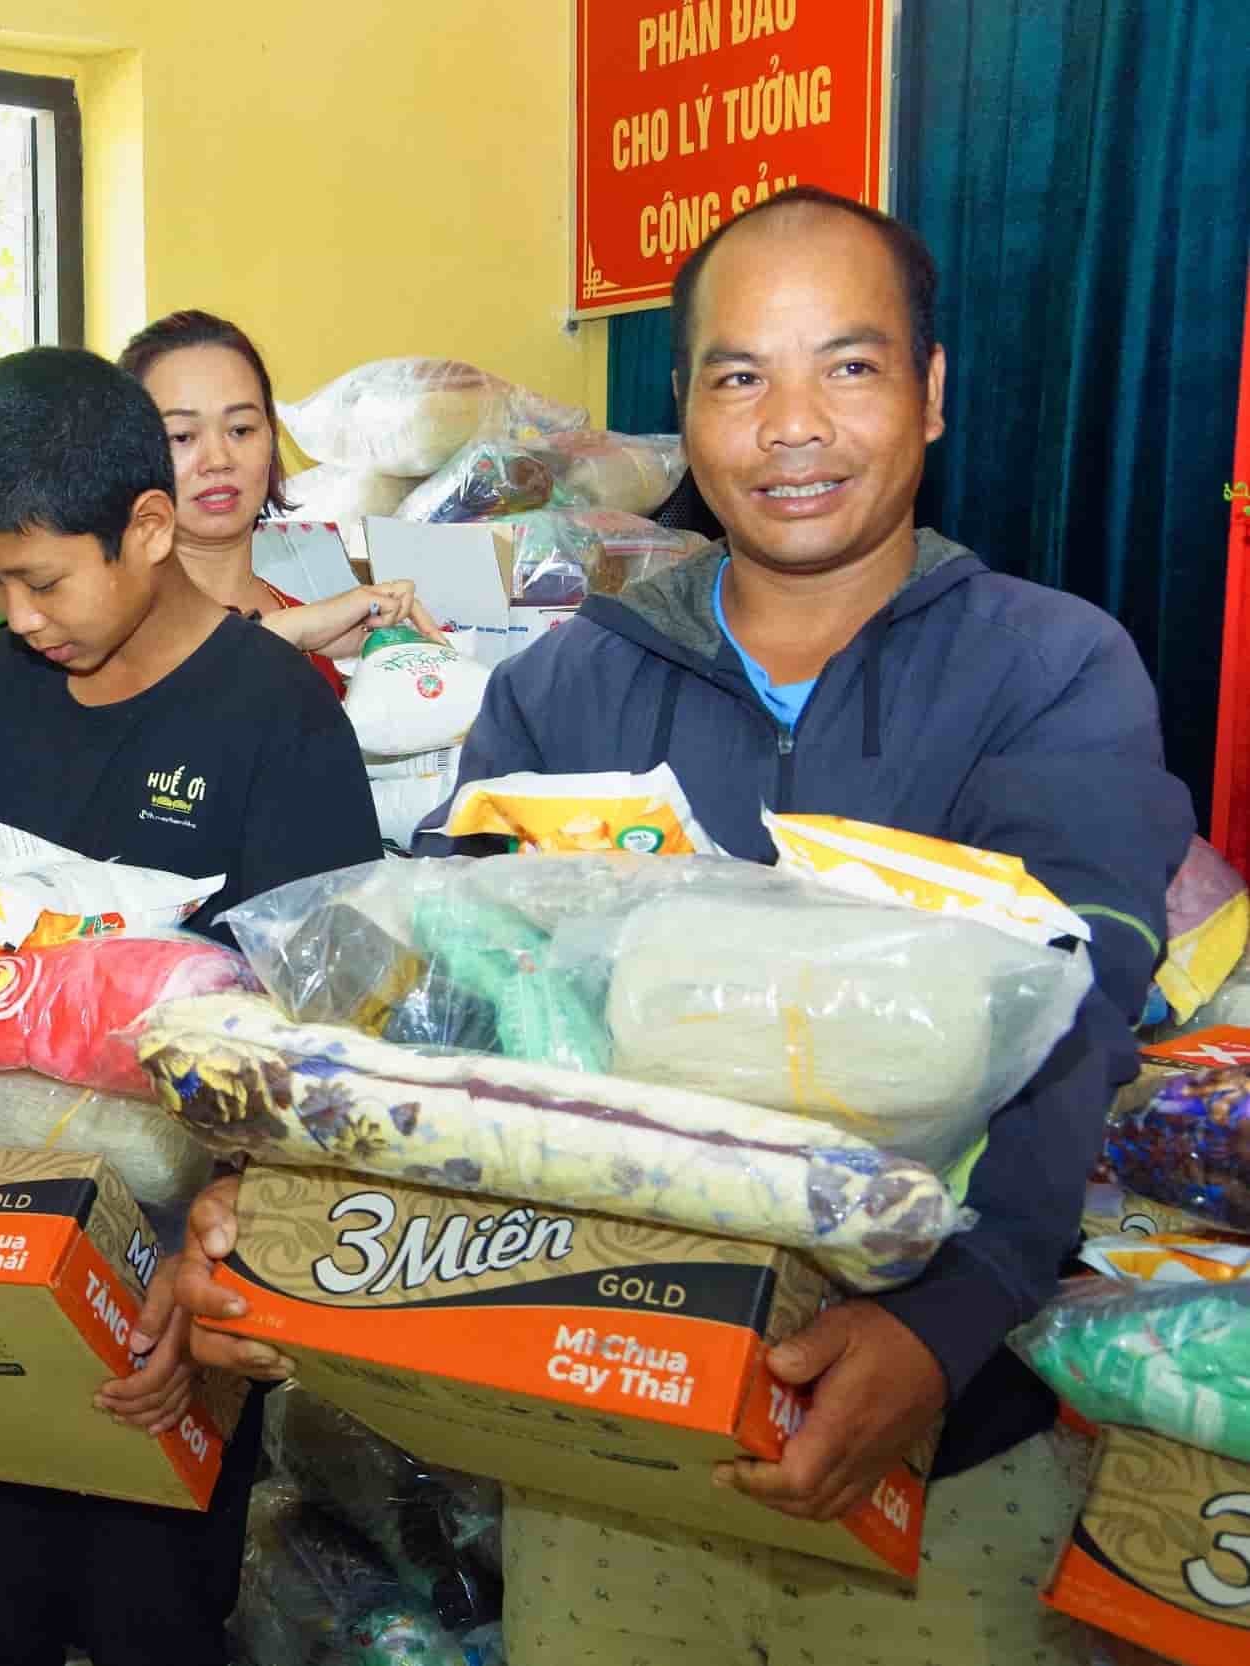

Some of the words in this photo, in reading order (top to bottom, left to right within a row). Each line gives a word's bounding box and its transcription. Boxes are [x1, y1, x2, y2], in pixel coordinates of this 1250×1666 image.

[612, 108, 669, 171] CHO
[679, 83, 713, 156] LÝ
[722, 54, 831, 145] TƯỞNG
[640, 190, 721, 264] CỘNG
[147, 765, 186, 796] HUẾ
[597, 1274, 686, 1308] GOLD
[554, 1324, 596, 1356] Mì
[598, 1334, 688, 1374] Chua
[546, 1354, 610, 1393] Cay
[612, 1367, 695, 1407] Thái
